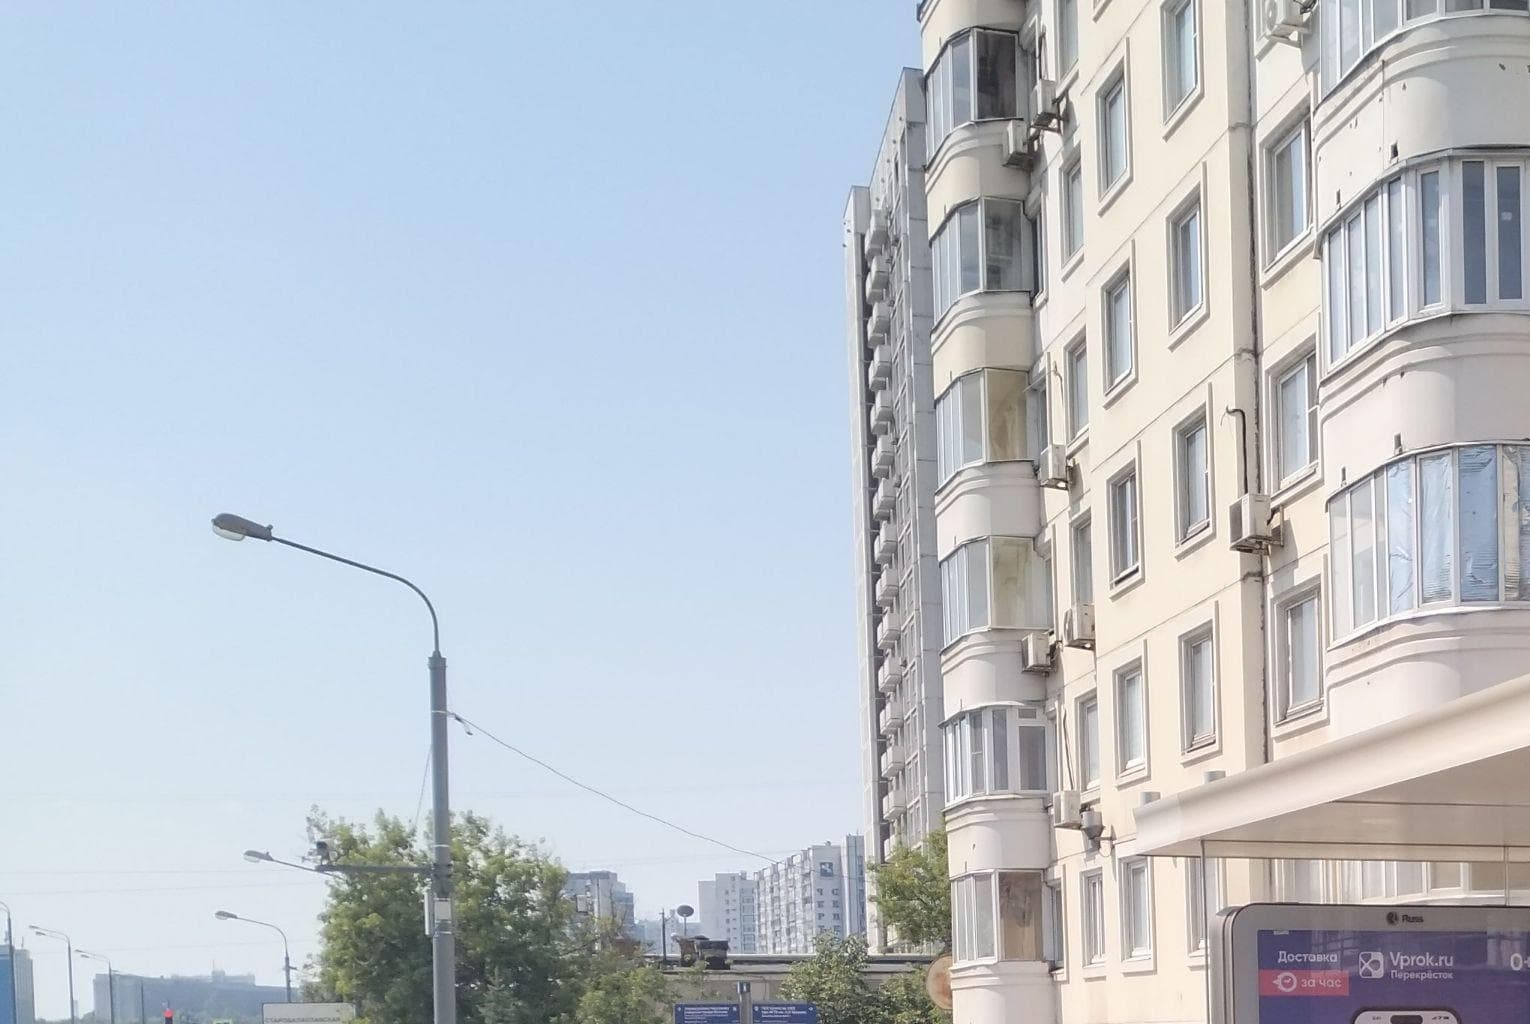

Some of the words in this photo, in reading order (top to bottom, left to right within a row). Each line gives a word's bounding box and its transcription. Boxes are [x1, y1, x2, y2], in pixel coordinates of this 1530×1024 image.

[1277, 951, 1338, 964] Доставка
[1390, 951, 1454, 970] Vprok.ru
[1301, 979, 1316, 988] за
[1319, 979, 1342, 989] час
